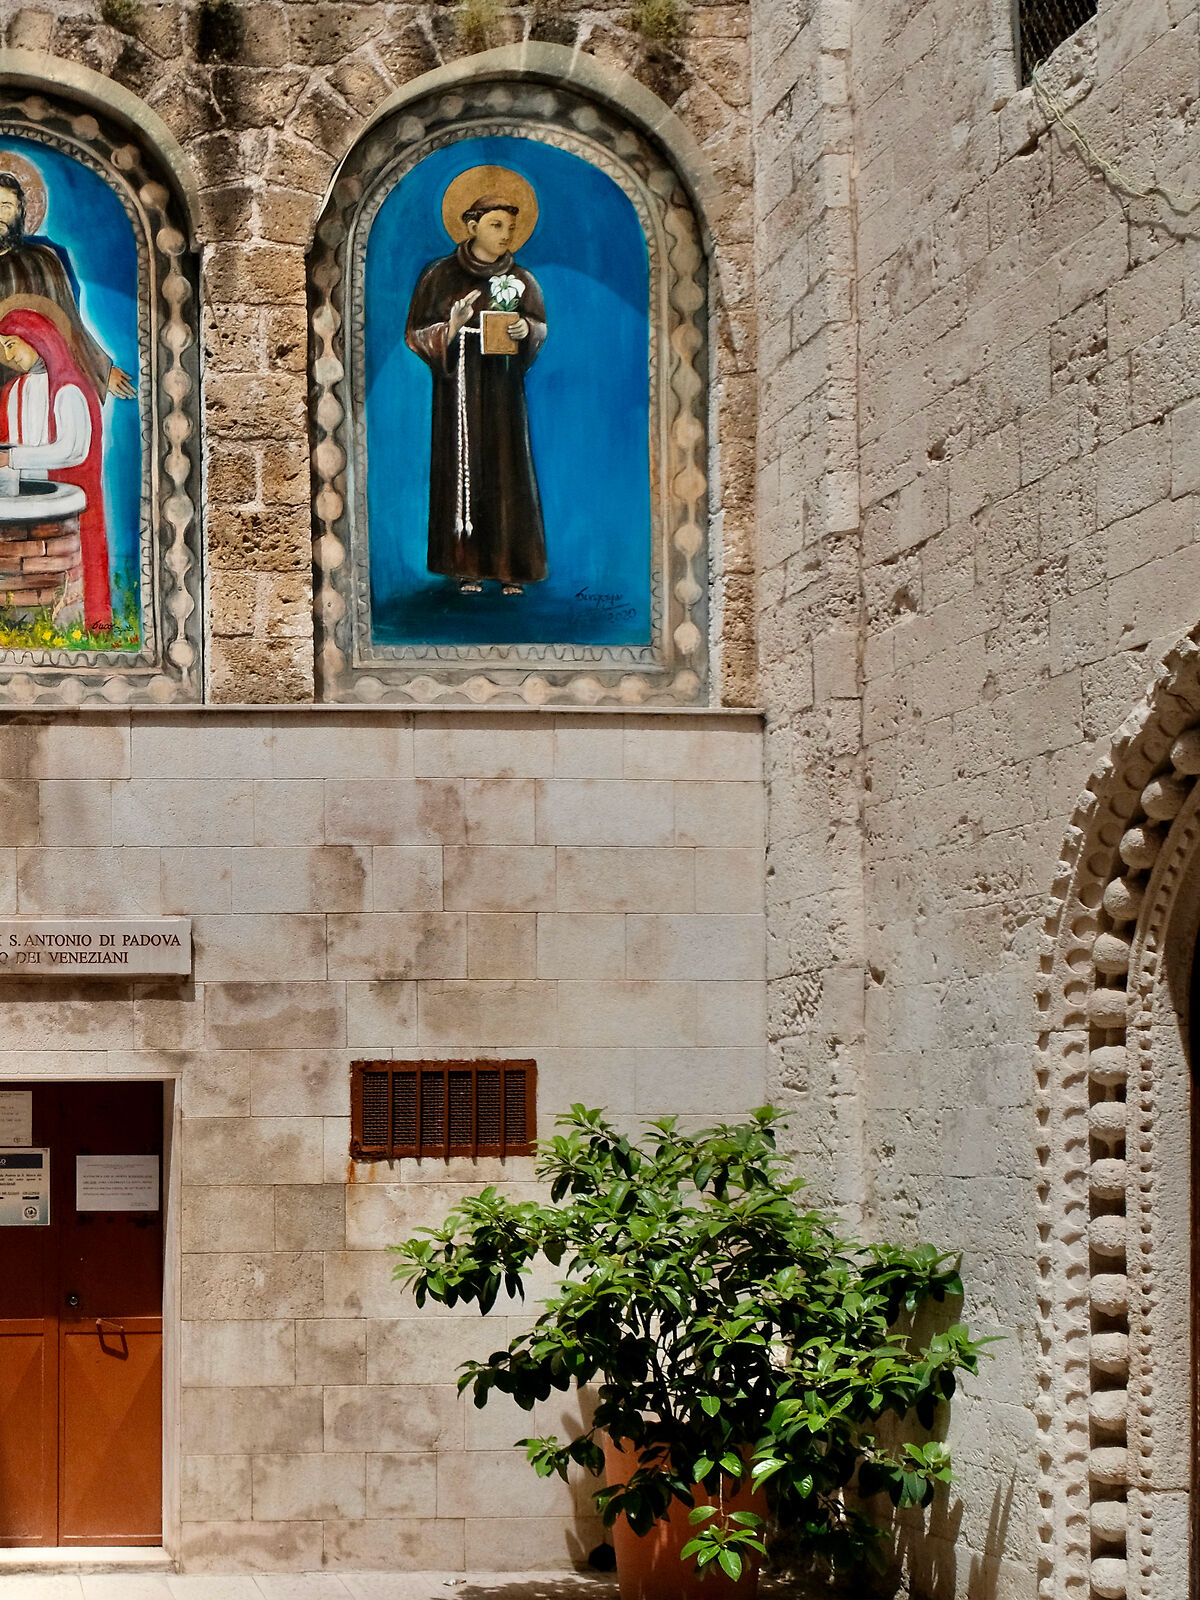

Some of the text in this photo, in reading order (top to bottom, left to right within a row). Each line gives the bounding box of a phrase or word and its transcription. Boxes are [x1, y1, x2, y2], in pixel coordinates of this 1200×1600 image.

[9, 934, 21, 947] S.
[24, 934, 92, 947] ANTONIO
[99, 934, 115, 947] DI
[122, 934, 181, 947] PADOVA
[16, 951, 41, 964] DEI
[50, 951, 129, 964] VENEZIANI
